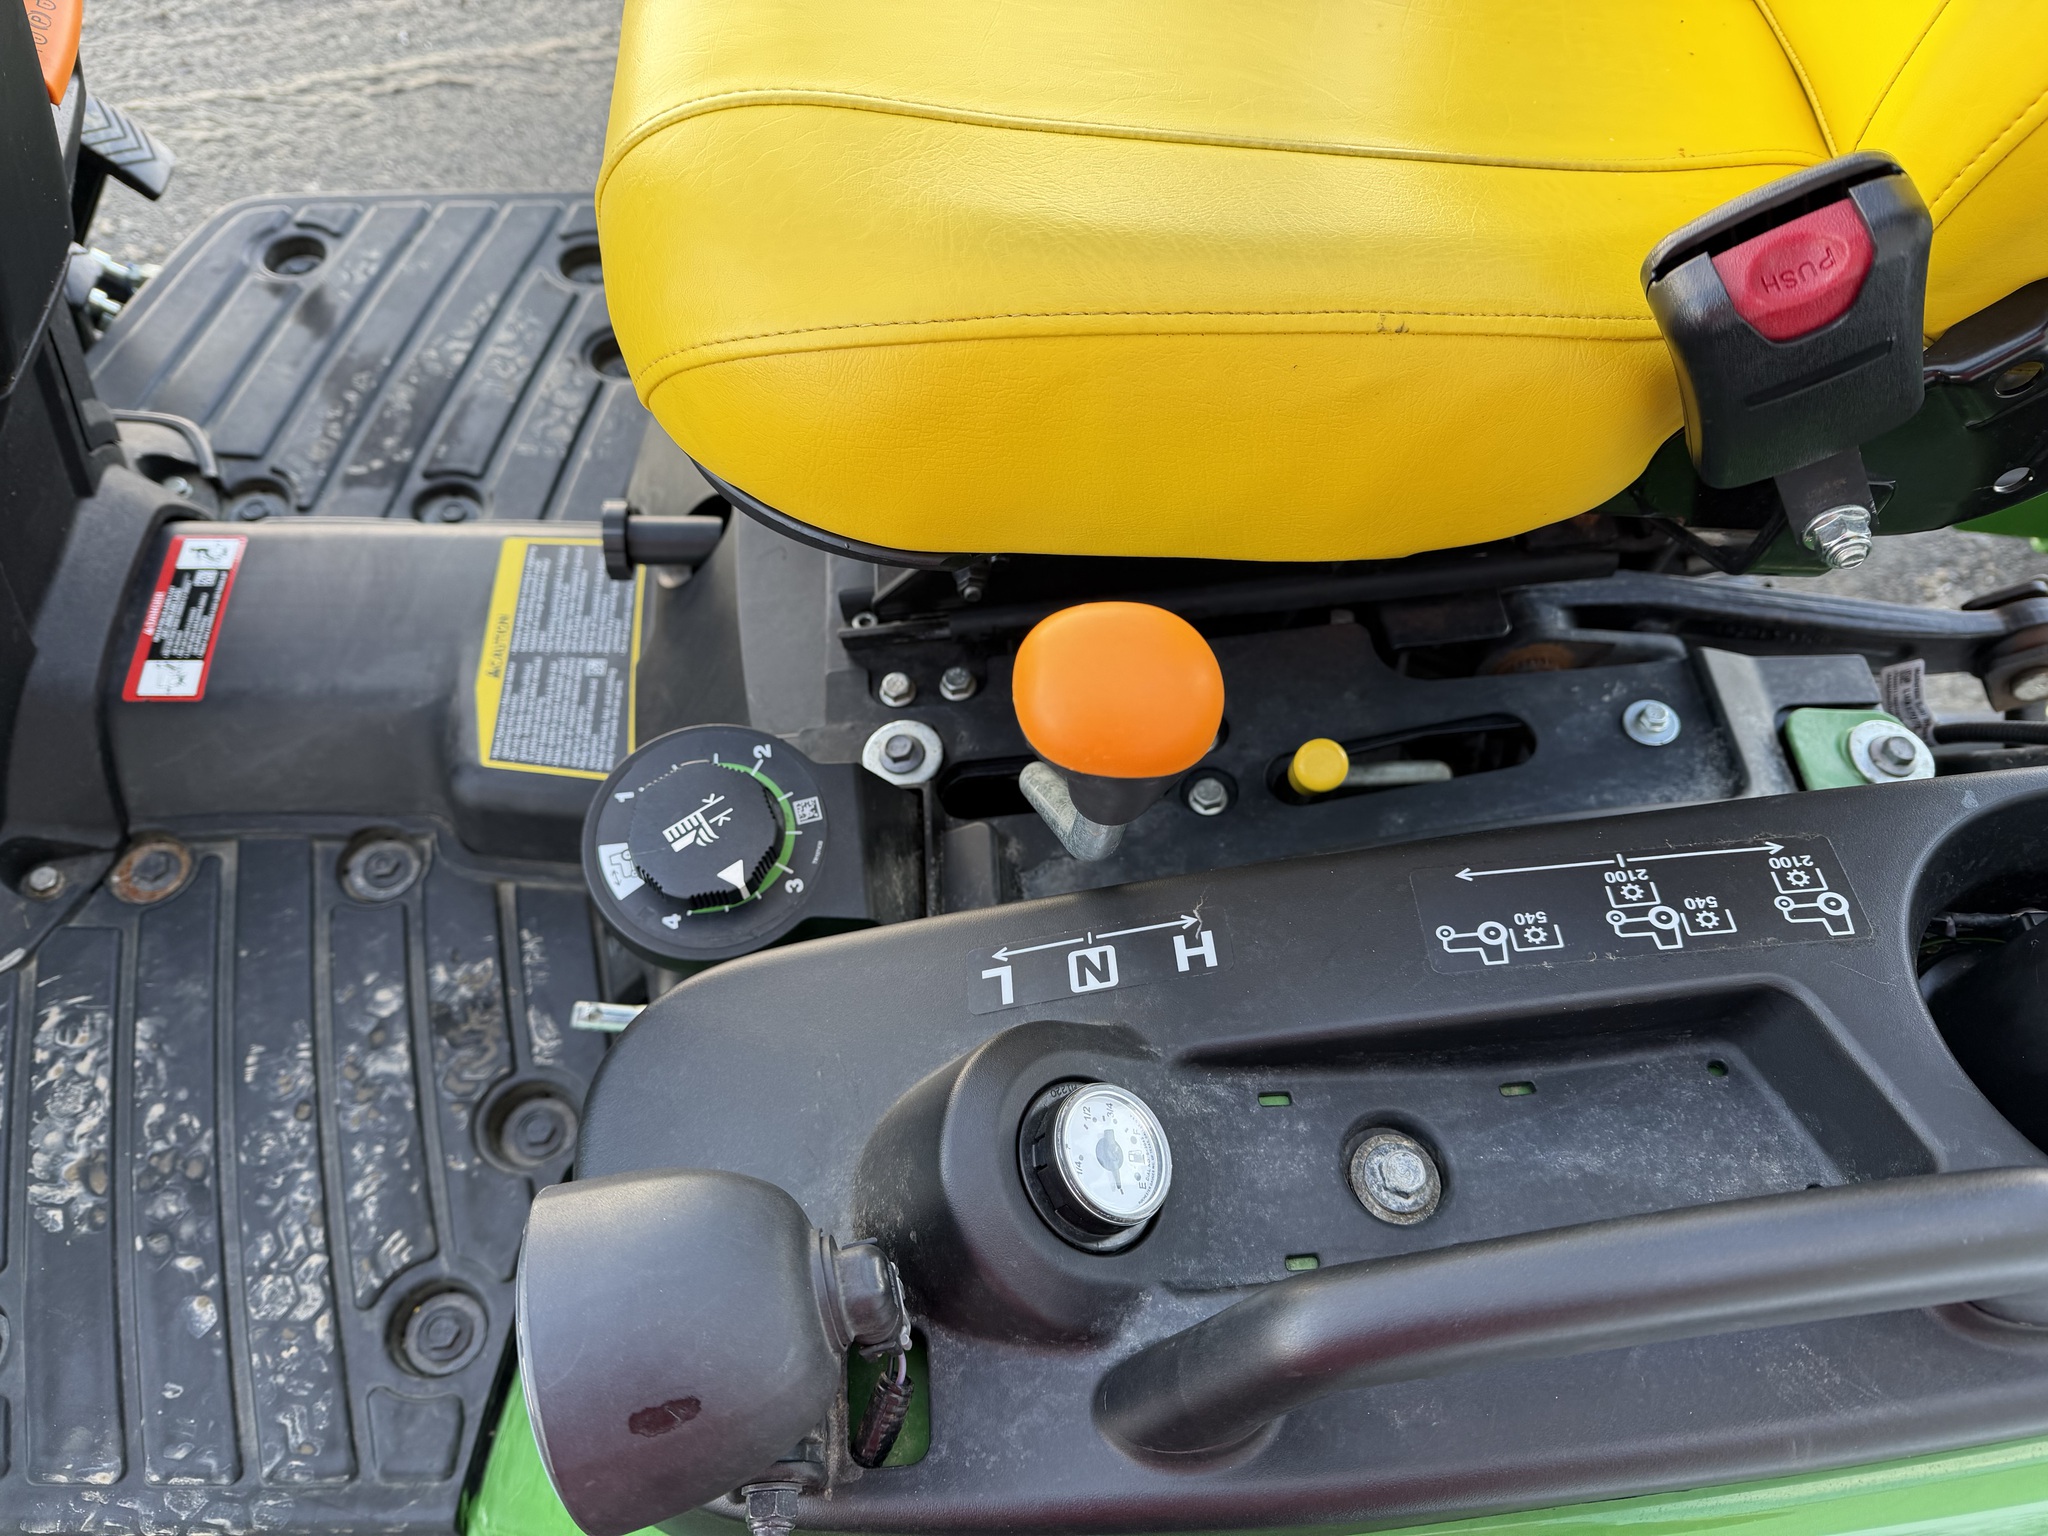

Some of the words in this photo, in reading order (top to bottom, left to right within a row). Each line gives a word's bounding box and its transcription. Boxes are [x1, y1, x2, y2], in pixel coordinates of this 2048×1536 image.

[1761, 246, 1836, 294] PUSH
[489, 613, 511, 669] CAUTION
[753, 743, 772, 759] 2
[614, 791, 635, 803] 1
[1769, 854, 1814, 870] 2100
[1603, 868, 1649, 884] 2100
[785, 878, 804, 893] 3
[1684, 895, 1719, 911] 540
[661, 913, 682, 930] 4
[1513, 910, 1548, 926] 540
[1173, 930, 1218, 972] H
[1075, 950, 1111, 988] N
[981, 965, 1014, 1005] L
[1082, 1105, 1091, 1120] 1/2
[1074, 1160, 1084, 1175] 1/4
[1138, 1181, 1147, 1190] E
